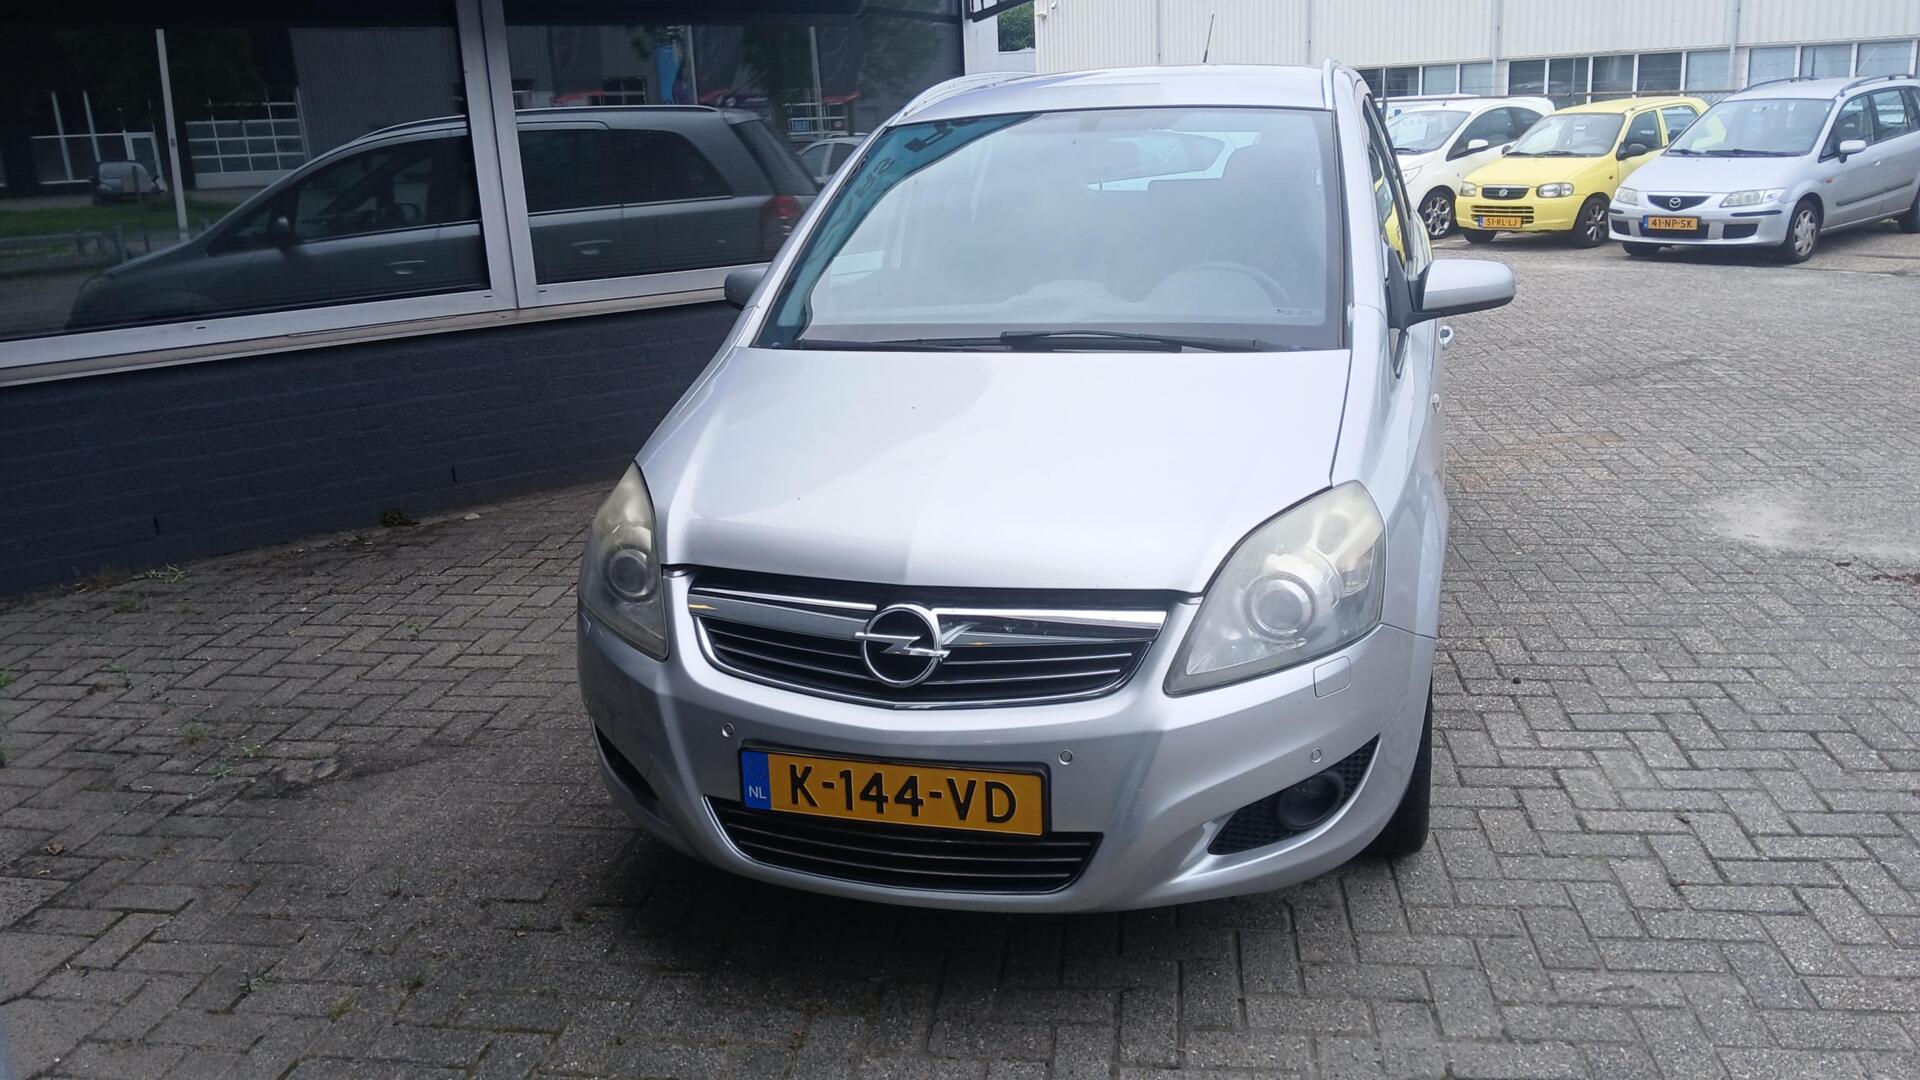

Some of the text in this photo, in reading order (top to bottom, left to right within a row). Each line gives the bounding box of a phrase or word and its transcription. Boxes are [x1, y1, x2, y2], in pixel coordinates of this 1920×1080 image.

[1651, 218, 1693, 228] 41-NP-SK
[749, 763, 1017, 824] NL K-144-VD
